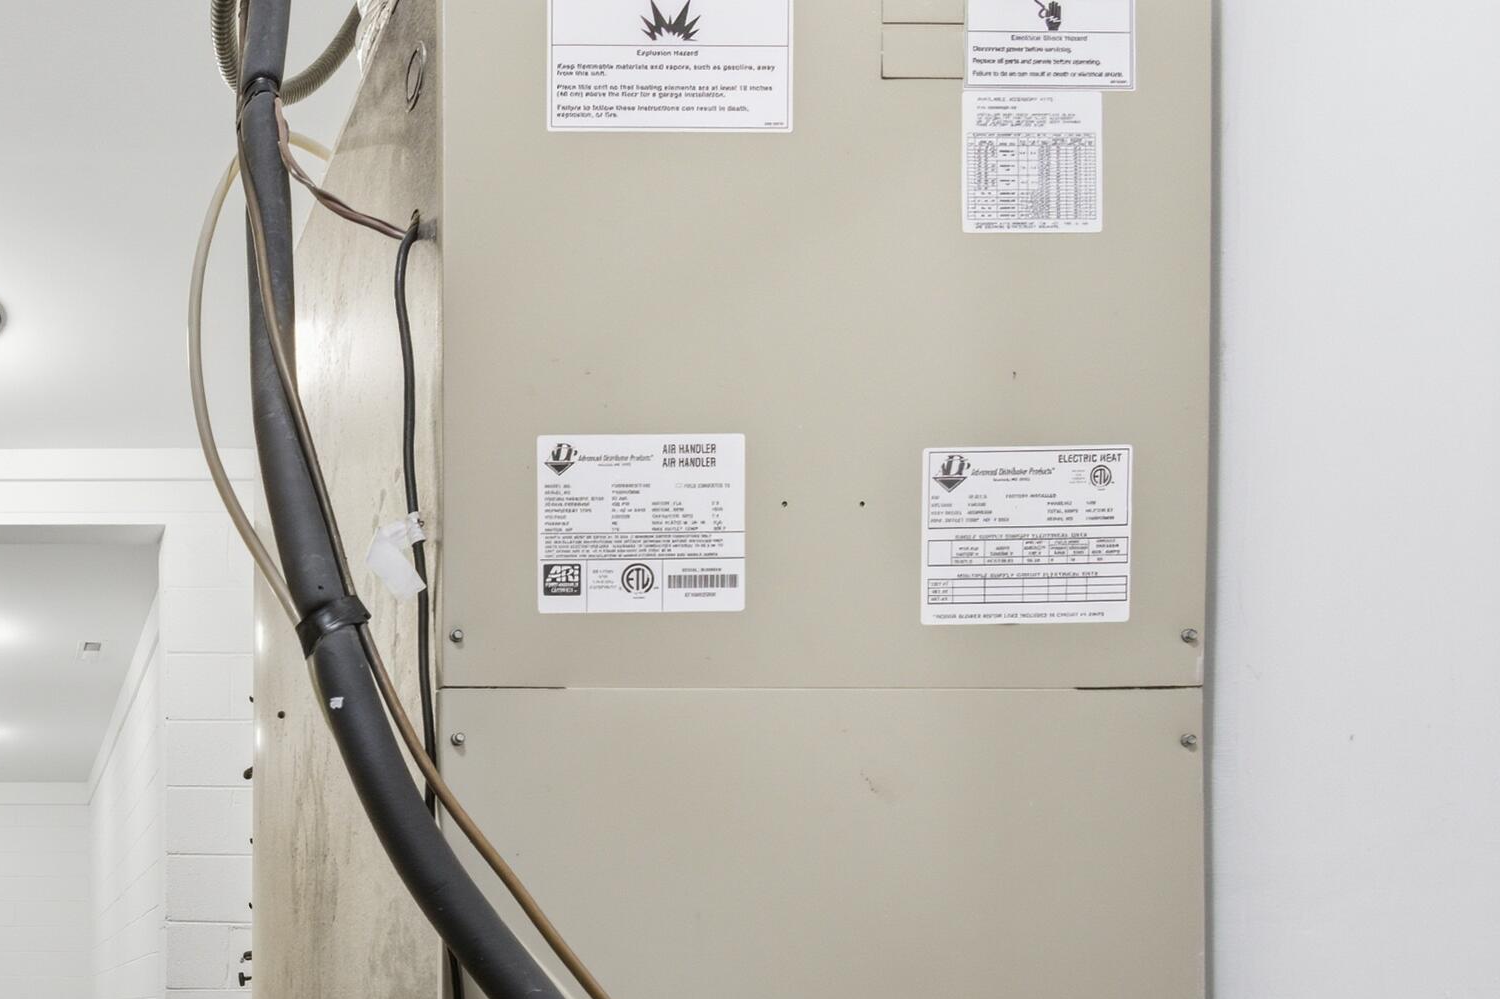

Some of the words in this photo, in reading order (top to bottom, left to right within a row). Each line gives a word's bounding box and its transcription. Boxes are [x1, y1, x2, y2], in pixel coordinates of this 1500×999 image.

[662, 444, 676, 454] AIR
[679, 444, 716, 453] HANDLER
[662, 458, 676, 467] AIR
[679, 457, 716, 467] HANDLER
[1058, 454, 1097, 463] ELECTRIC
[1100, 454, 1122, 462] HEAT
